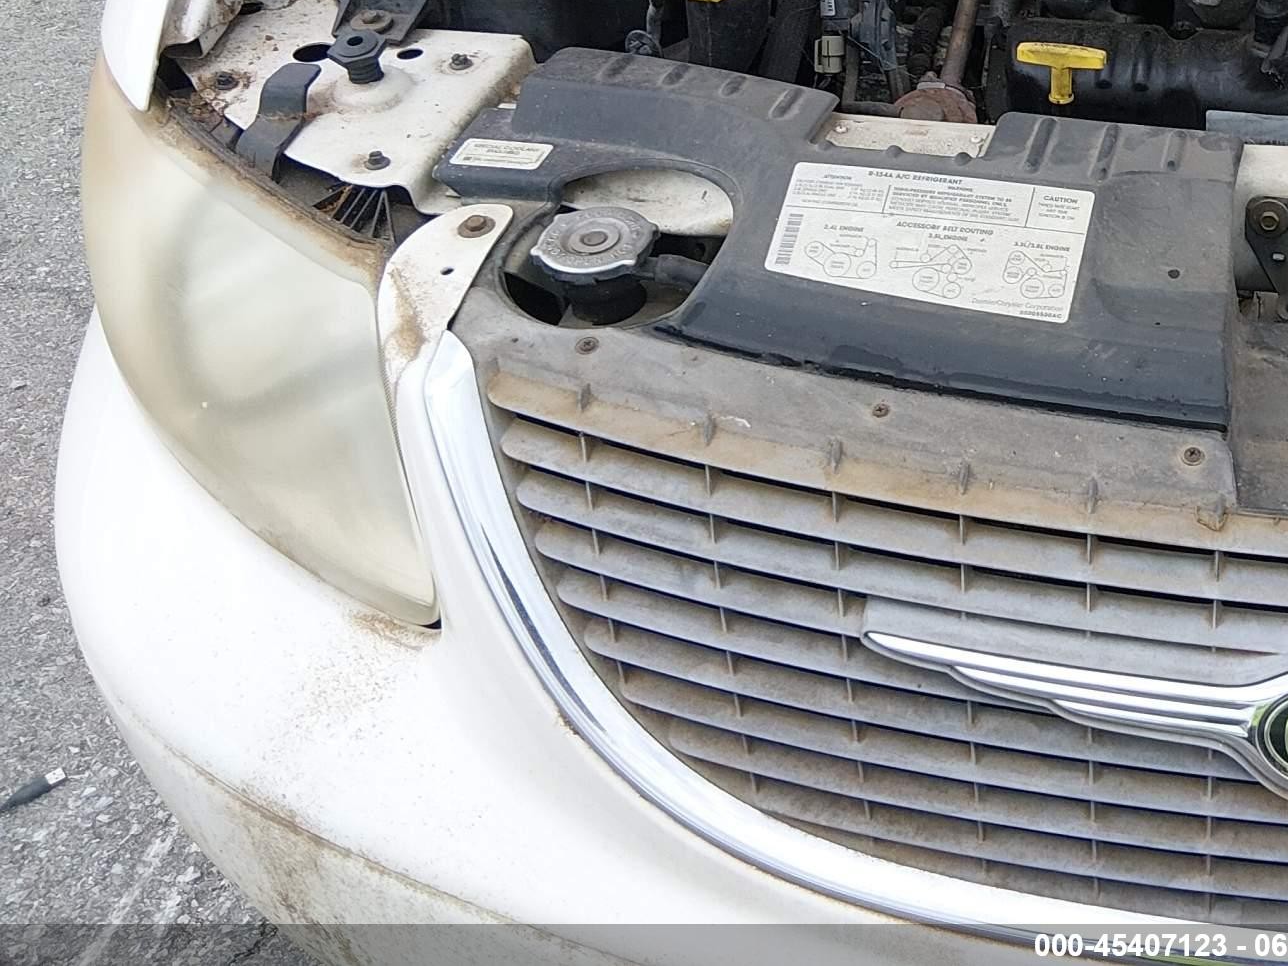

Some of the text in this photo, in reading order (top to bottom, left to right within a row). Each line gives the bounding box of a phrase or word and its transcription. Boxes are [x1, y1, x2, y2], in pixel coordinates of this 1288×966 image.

[895, 172, 911, 180] A/C
[913, 175, 963, 185] REFRIGERANT
[1043, 195, 1079, 204] CAUTION
[896, 221, 940, 231] ACCESSORY
[959, 226, 994, 236] ROUTING
[943, 234, 968, 242] ENGINE
[1045, 244, 1071, 252] ENGINE
